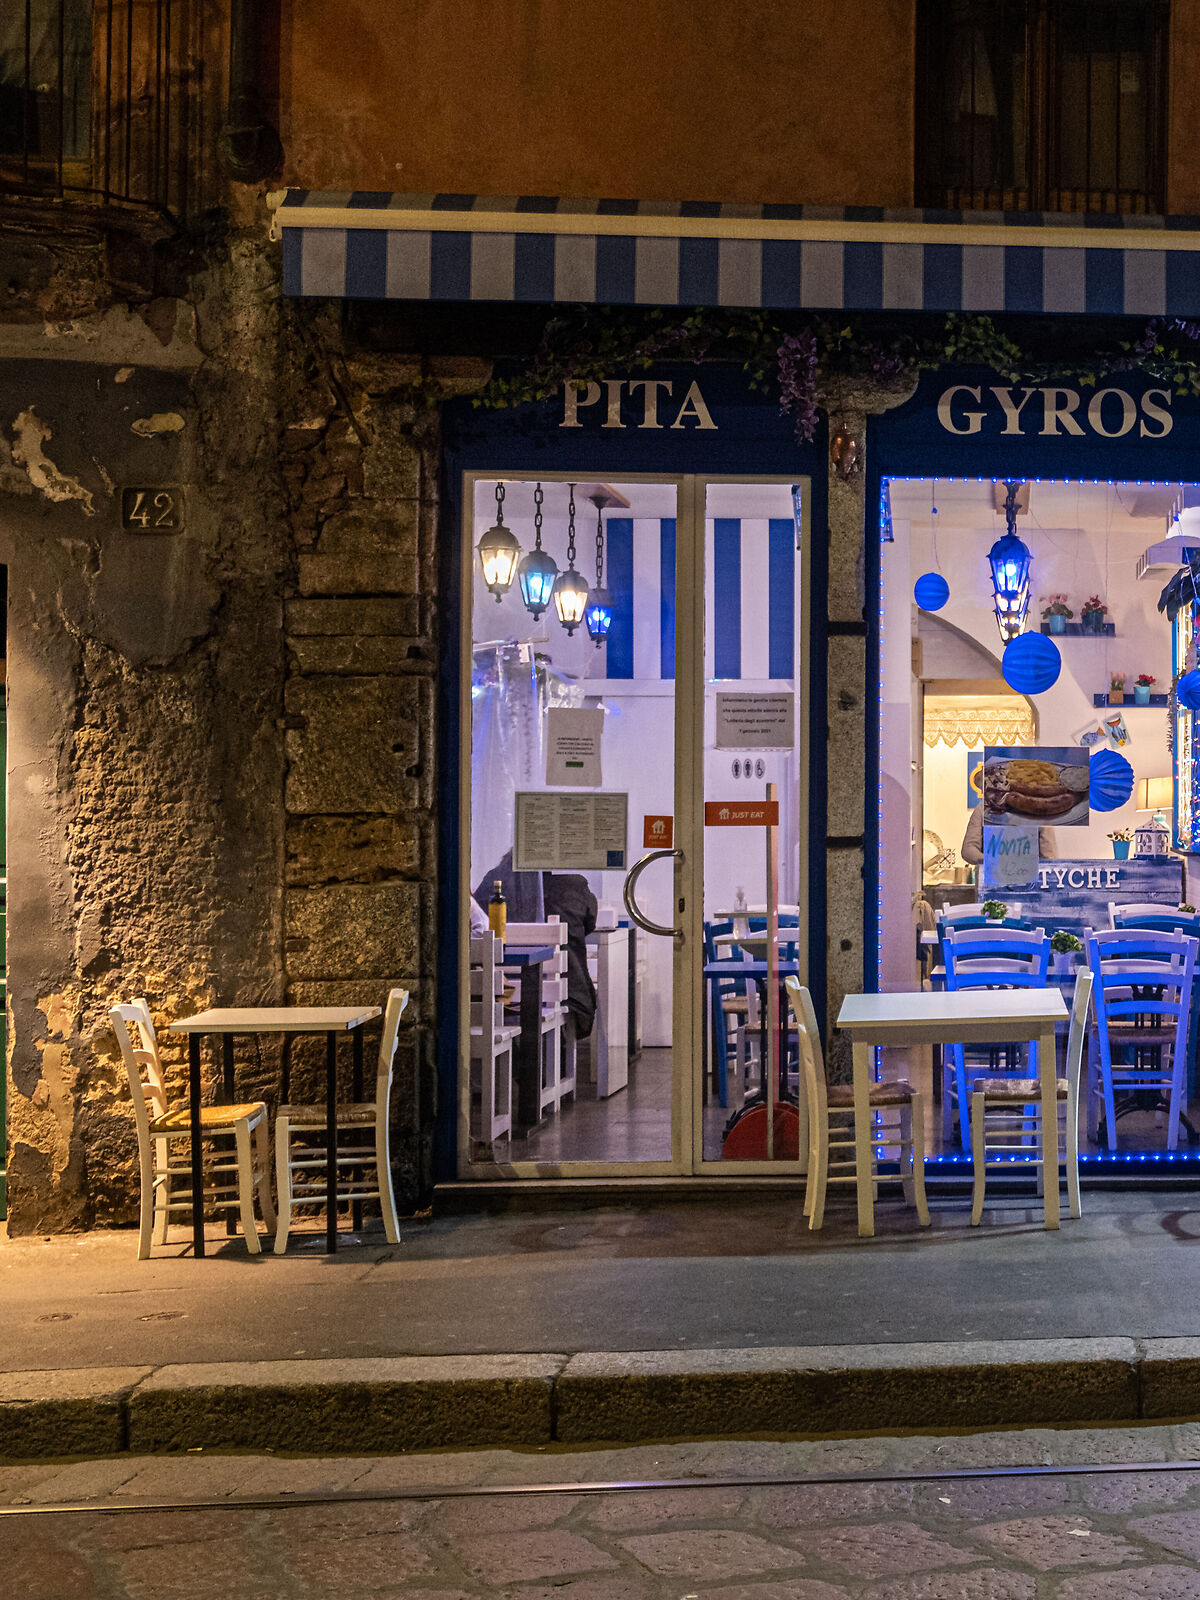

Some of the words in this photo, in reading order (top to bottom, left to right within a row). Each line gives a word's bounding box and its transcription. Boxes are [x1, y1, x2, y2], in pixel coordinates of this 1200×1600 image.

[559, 379, 719, 430] PITA
[937, 385, 1174, 438] GYROS
[129, 492, 174, 528] 42
[732, 811, 749, 819] JUST
[1038, 867, 1120, 889] TYCHE
